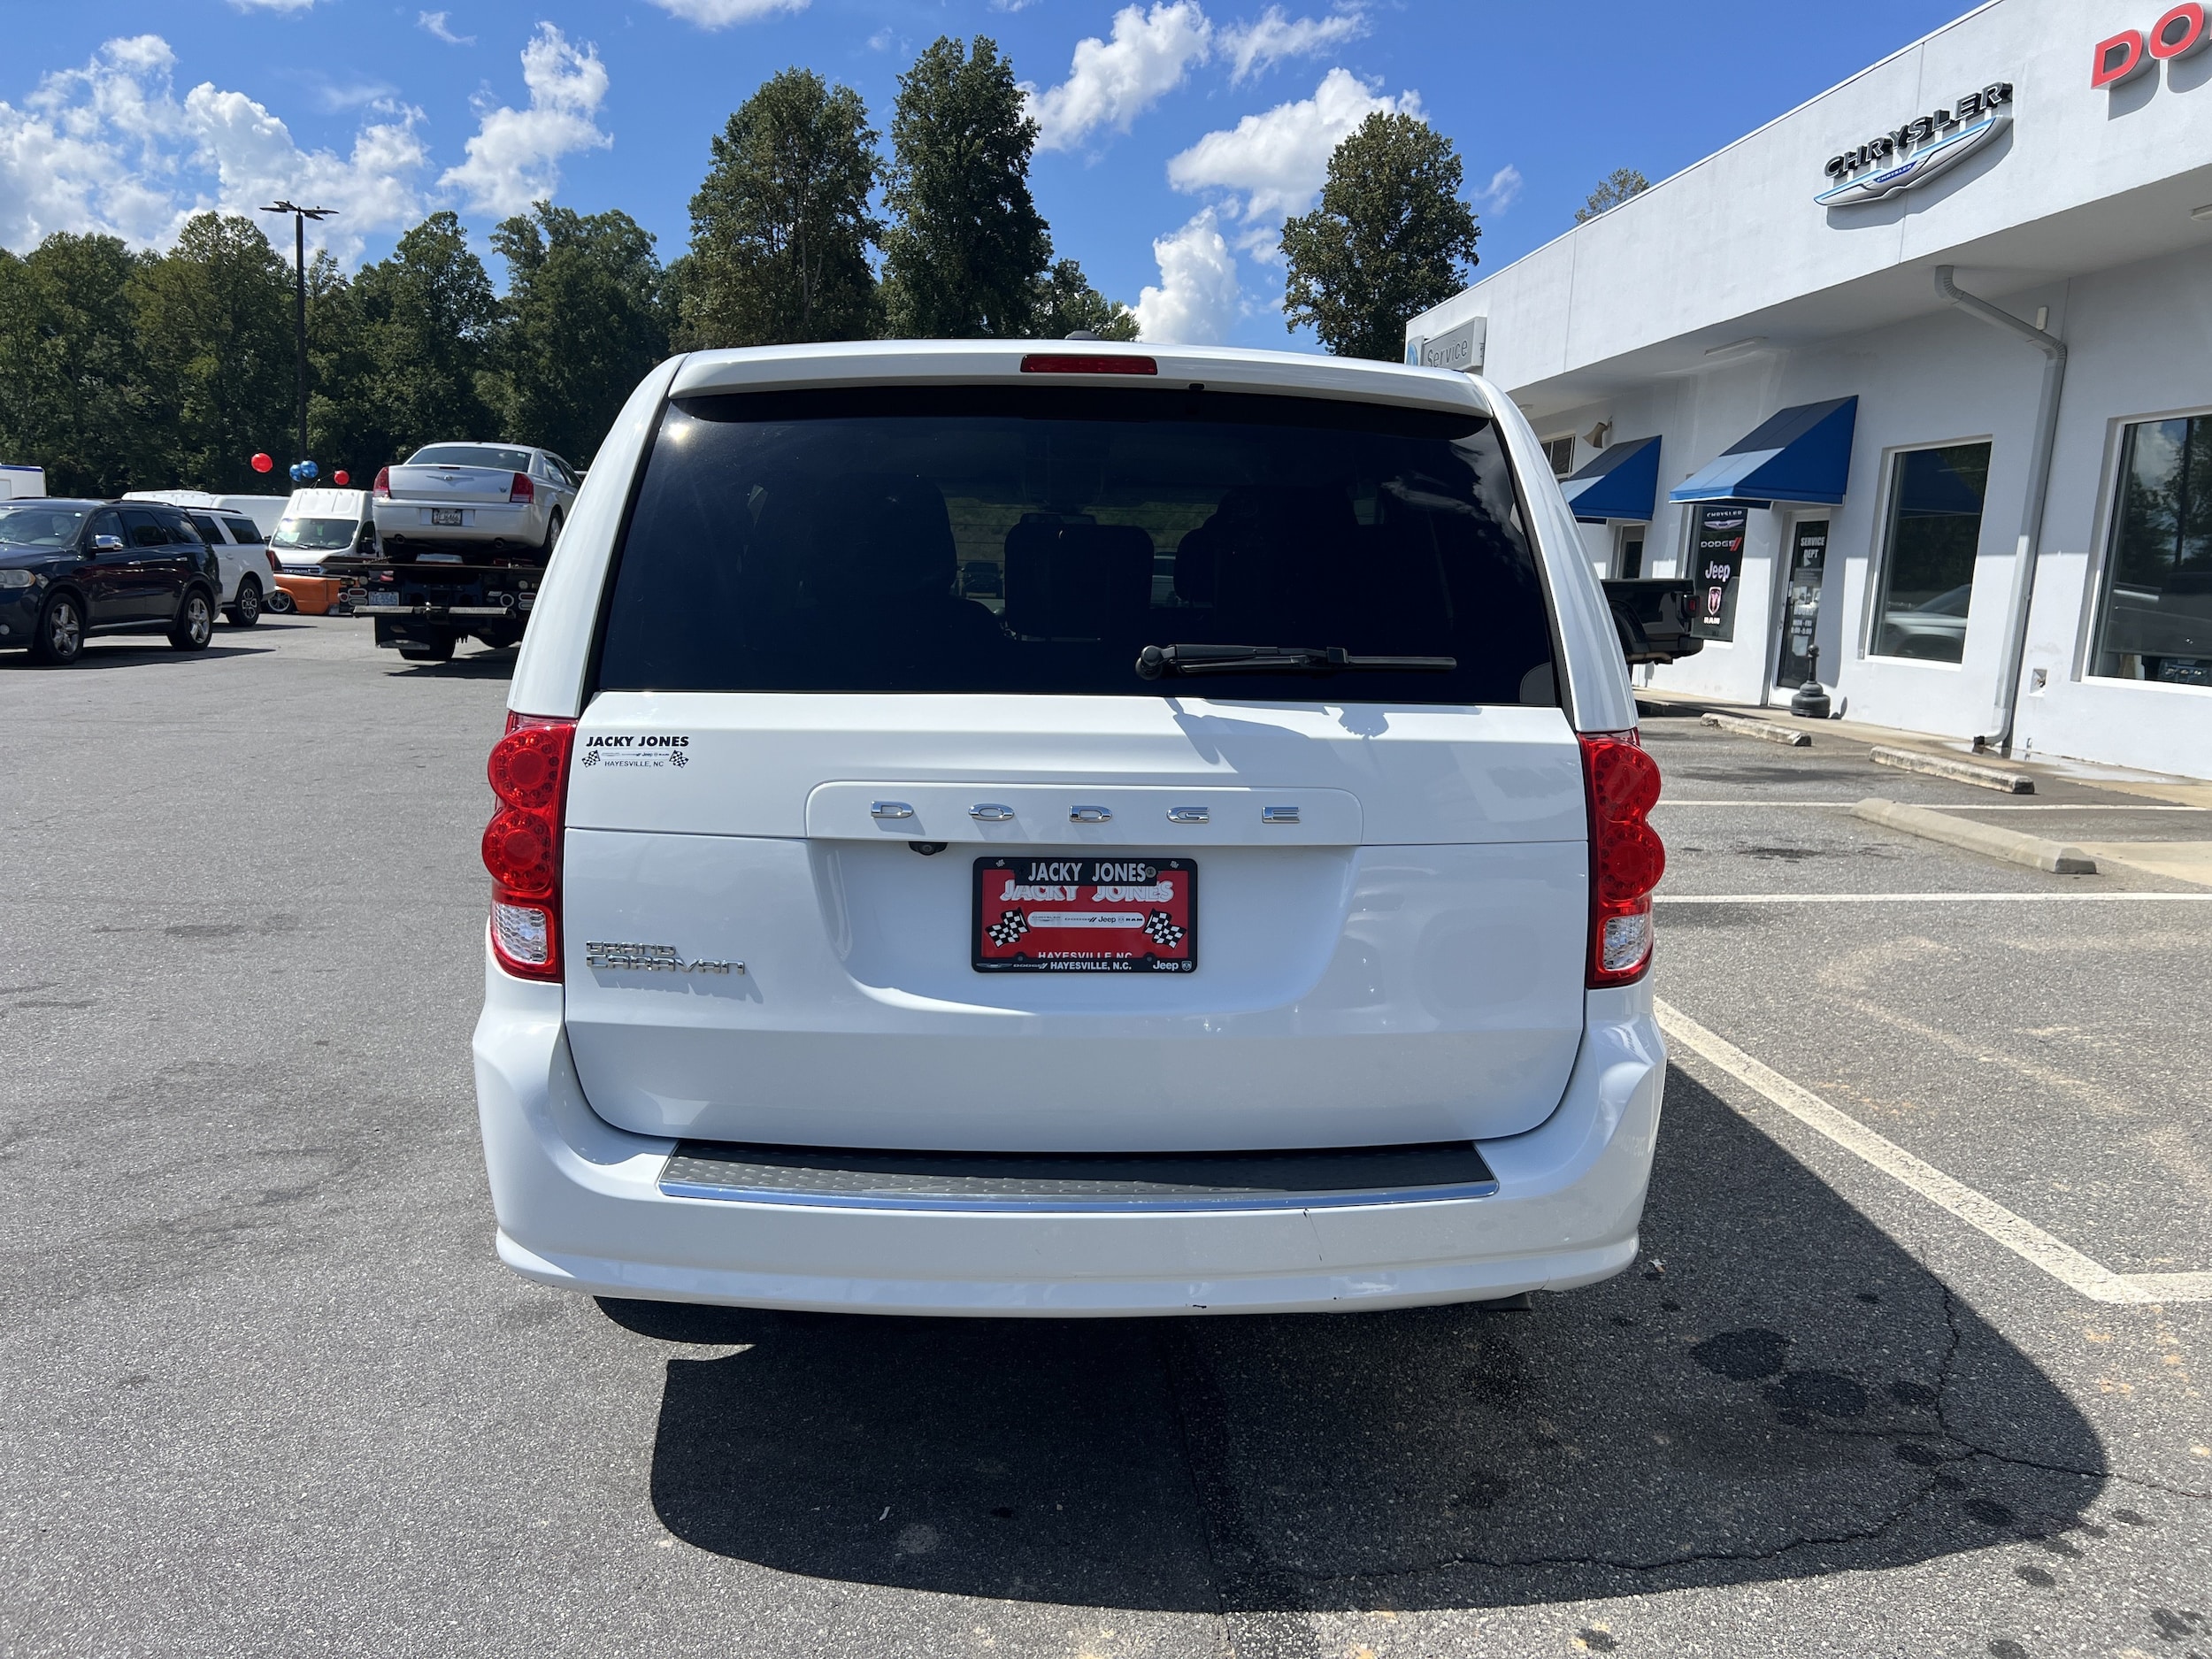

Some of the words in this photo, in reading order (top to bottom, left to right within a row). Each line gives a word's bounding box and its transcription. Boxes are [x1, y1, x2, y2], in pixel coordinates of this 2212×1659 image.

[2091, 2, 2212, 89] DO
[1824, 81, 2012, 178] CHRYSLER
[1877, 164, 1913, 182] CHRYSLER
[1427, 340, 1468, 367] Service
[1800, 536, 1825, 547] SERVICE
[1803, 549, 1819, 558] DEPT
[1705, 561, 1731, 582] Jeep
[586, 736, 634, 748] JACKY
[638, 736, 689, 748] JONES
[871, 800, 1302, 825] DODGE
[1028, 863, 1082, 882] JACKY
[1092, 863, 1147, 882] JONES
[1000, 880, 1080, 902] JACKY
[1092, 881, 1174, 902] JONES
[586, 941, 677, 956] GRAND
[586, 954, 746, 975] CARAVAN
[1050, 961, 1110, 971] HAYESVILLE,
[1112, 962, 1133, 971] N.C.
[1153, 960, 1179, 971] Jeep
